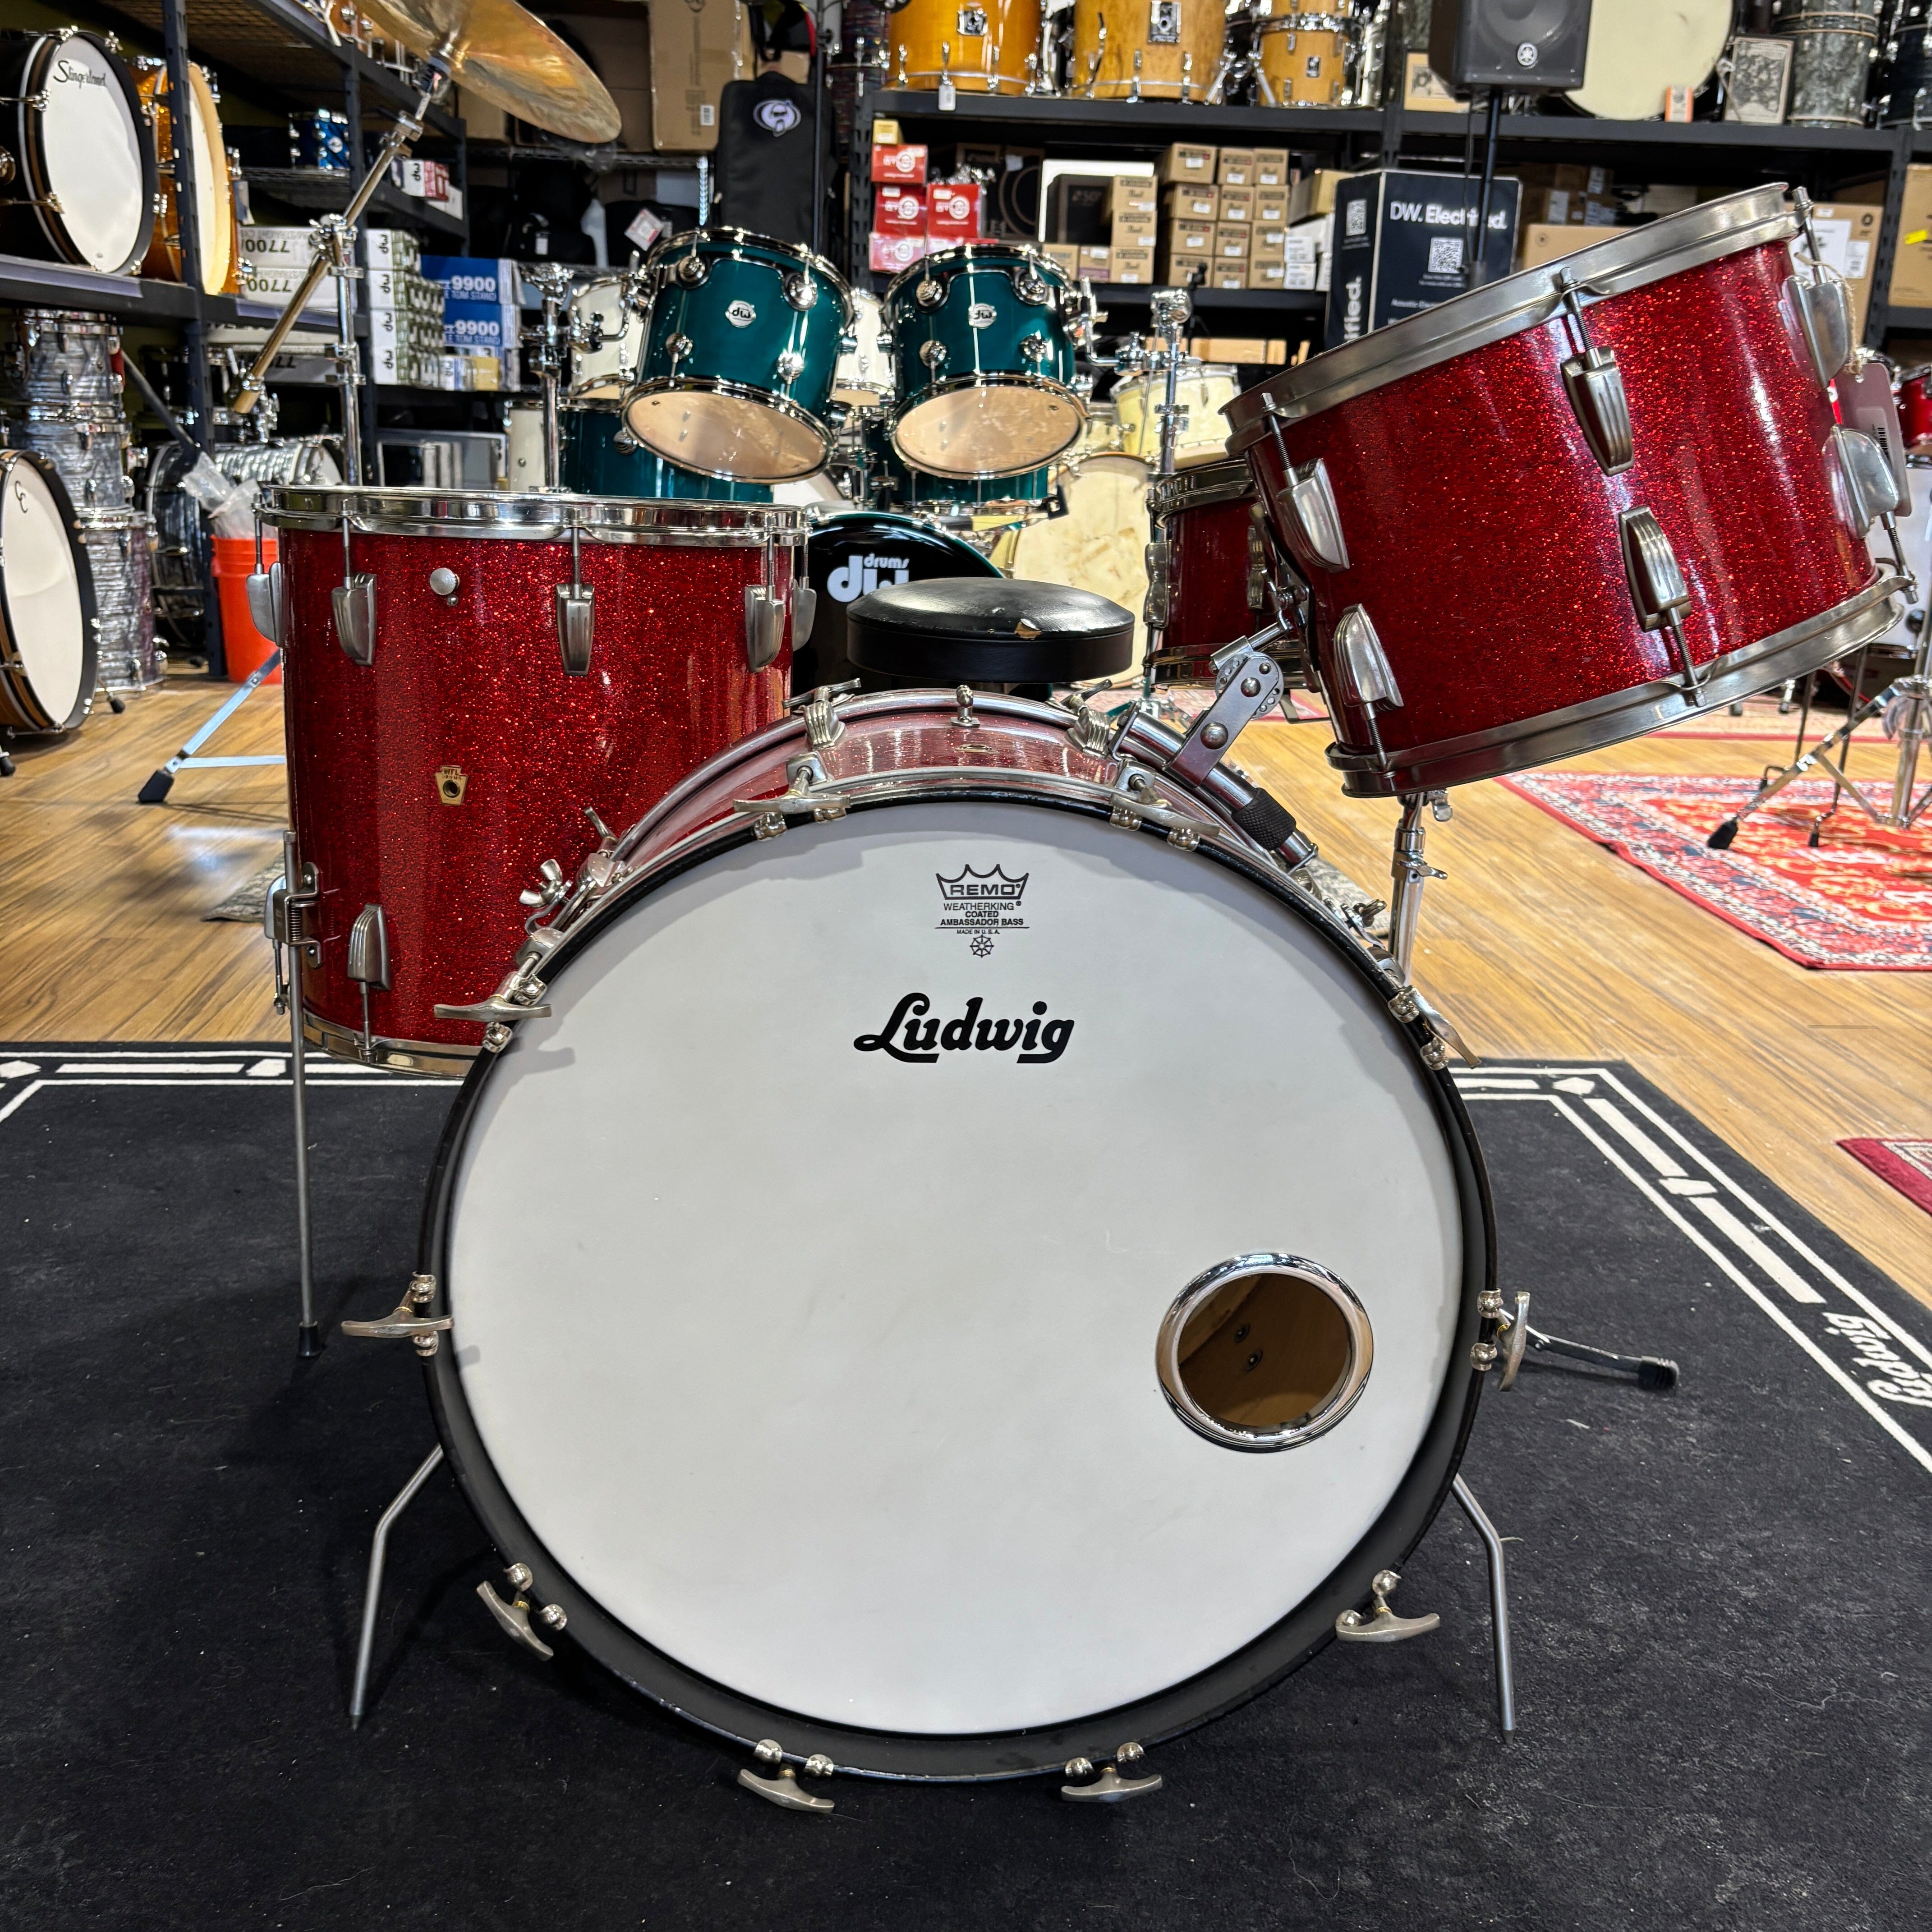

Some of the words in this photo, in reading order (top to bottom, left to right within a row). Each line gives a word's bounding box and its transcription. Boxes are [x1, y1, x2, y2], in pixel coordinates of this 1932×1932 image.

[245, 239, 290, 253] 7700
[247, 279, 293, 292] 7700
[451, 275, 496, 293] 9900
[731, 307, 751, 319] dw
[455, 318, 500, 337] 9900
[863, 552, 910, 569] drums
[854, 992, 1075, 1063] Ludwig
